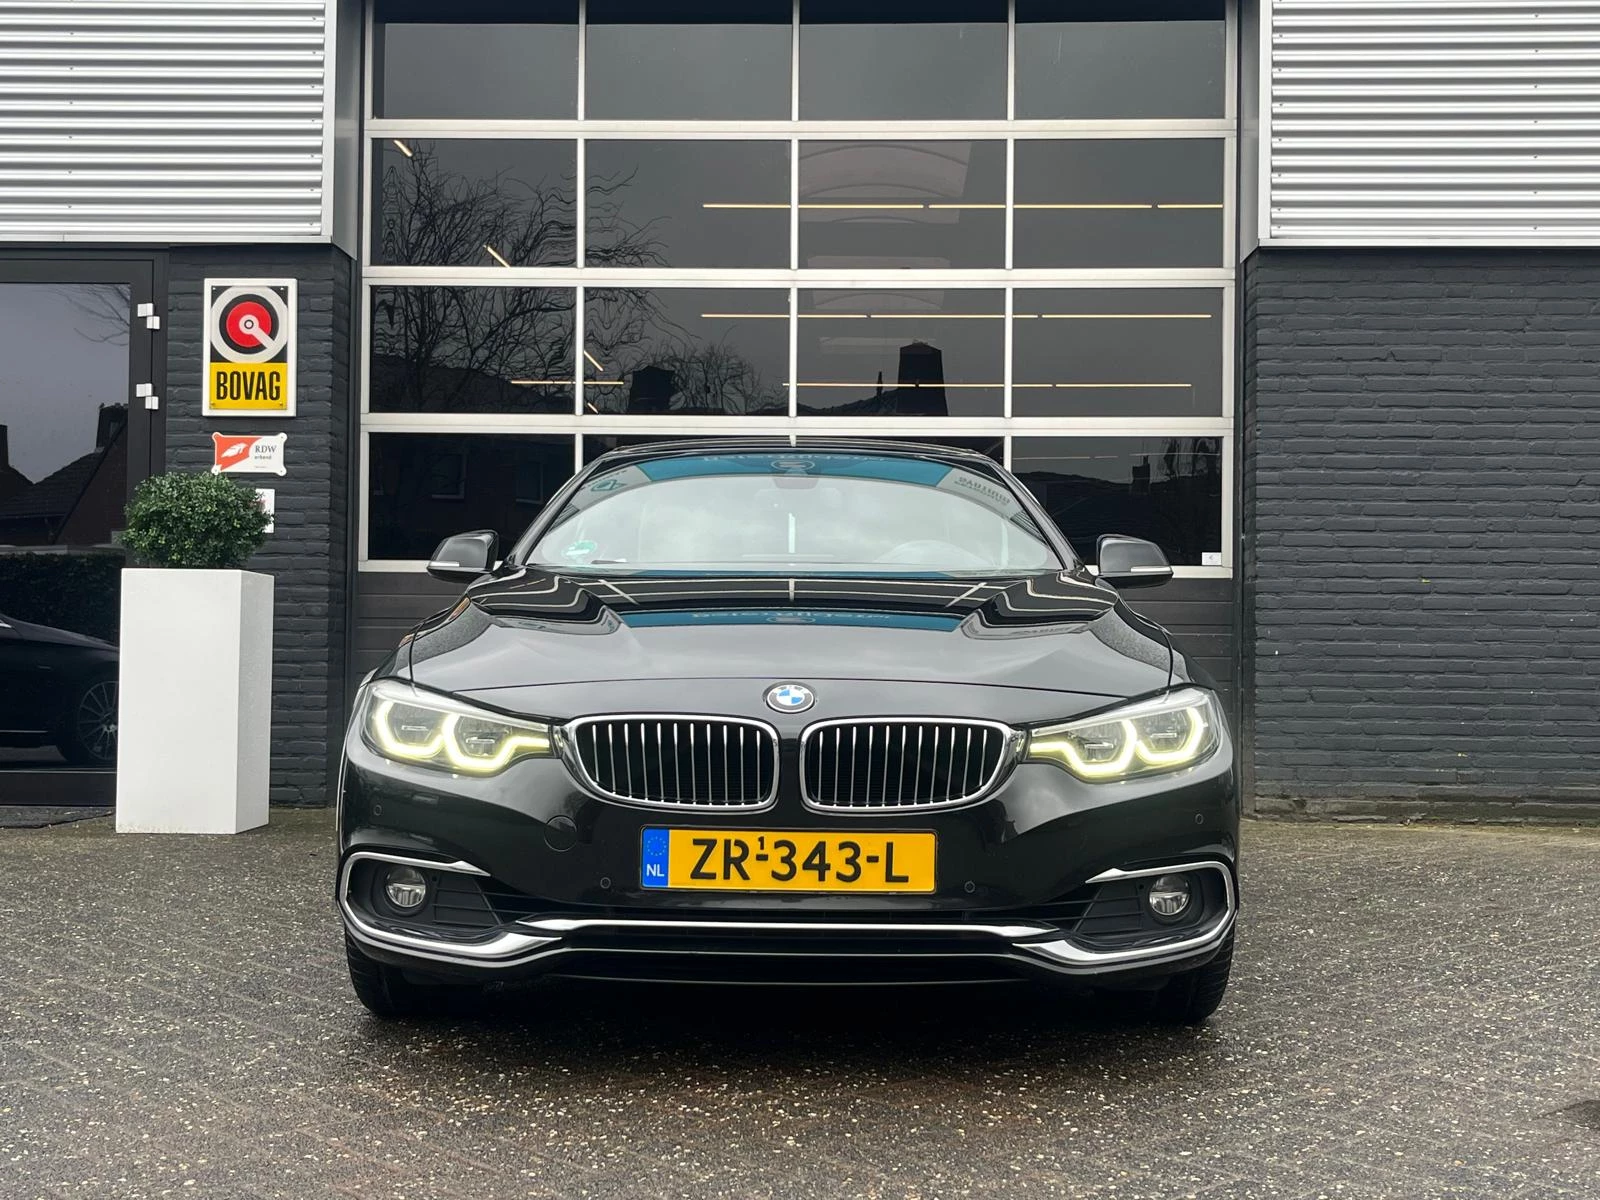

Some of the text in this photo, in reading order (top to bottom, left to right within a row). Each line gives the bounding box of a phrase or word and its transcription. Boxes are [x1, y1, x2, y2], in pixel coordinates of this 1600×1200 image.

[216, 370, 281, 401] BOVAG
[255, 445, 277, 453] RDW
[646, 864, 664, 877] NL
[690, 838, 909, 883] ZR-343-L
